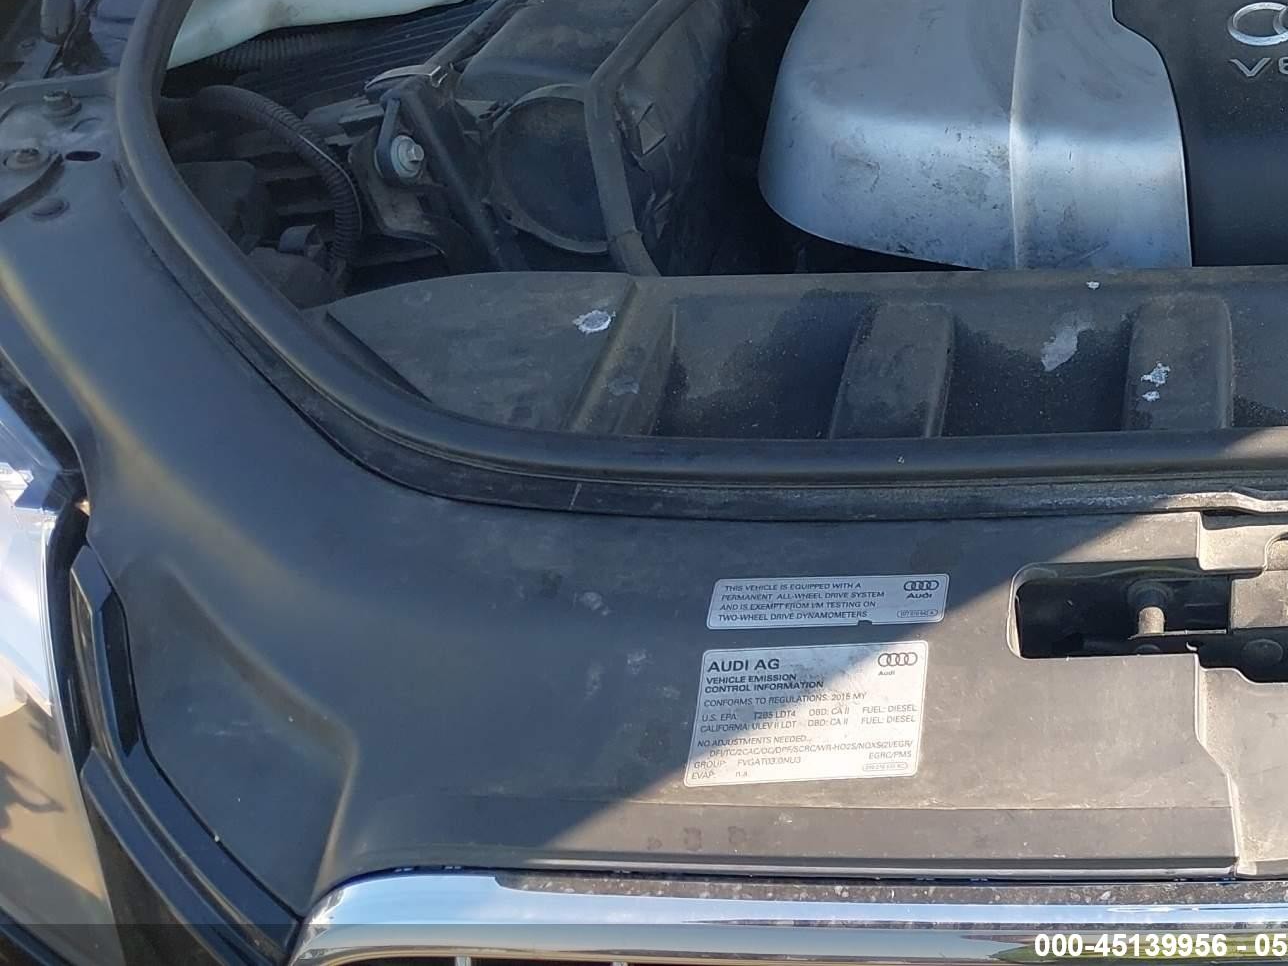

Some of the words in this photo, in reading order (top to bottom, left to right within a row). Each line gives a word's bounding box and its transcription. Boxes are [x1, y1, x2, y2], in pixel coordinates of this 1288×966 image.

[721, 593, 773, 601] PERMANENT
[777, 592, 823, 600] ALL-WHEEL
[797, 611, 867, 619] DYNAMOMETERS
[707, 659, 748, 672] AUDI
[754, 658, 780, 671] AG
[706, 675, 745, 684] VEHICLE
[748, 673, 796, 683] EMISSION
[704, 684, 751, 694] CONTROL
[754, 681, 824, 691] INFORMATION
[704, 697, 753, 707] CONFORMS
[755, 697, 766, 705] TO
[775, 710, 796, 719] LDT4
[831, 706, 843, 715] CA
[887, 704, 917, 713] DIESEL
[752, 721, 774, 730] ULEV
[781, 720, 797, 729] LDT
[830, 717, 842, 726] CA
[886, 715, 916, 723] DIESEL
[712, 736, 771, 746] ADJUSTMENTS
